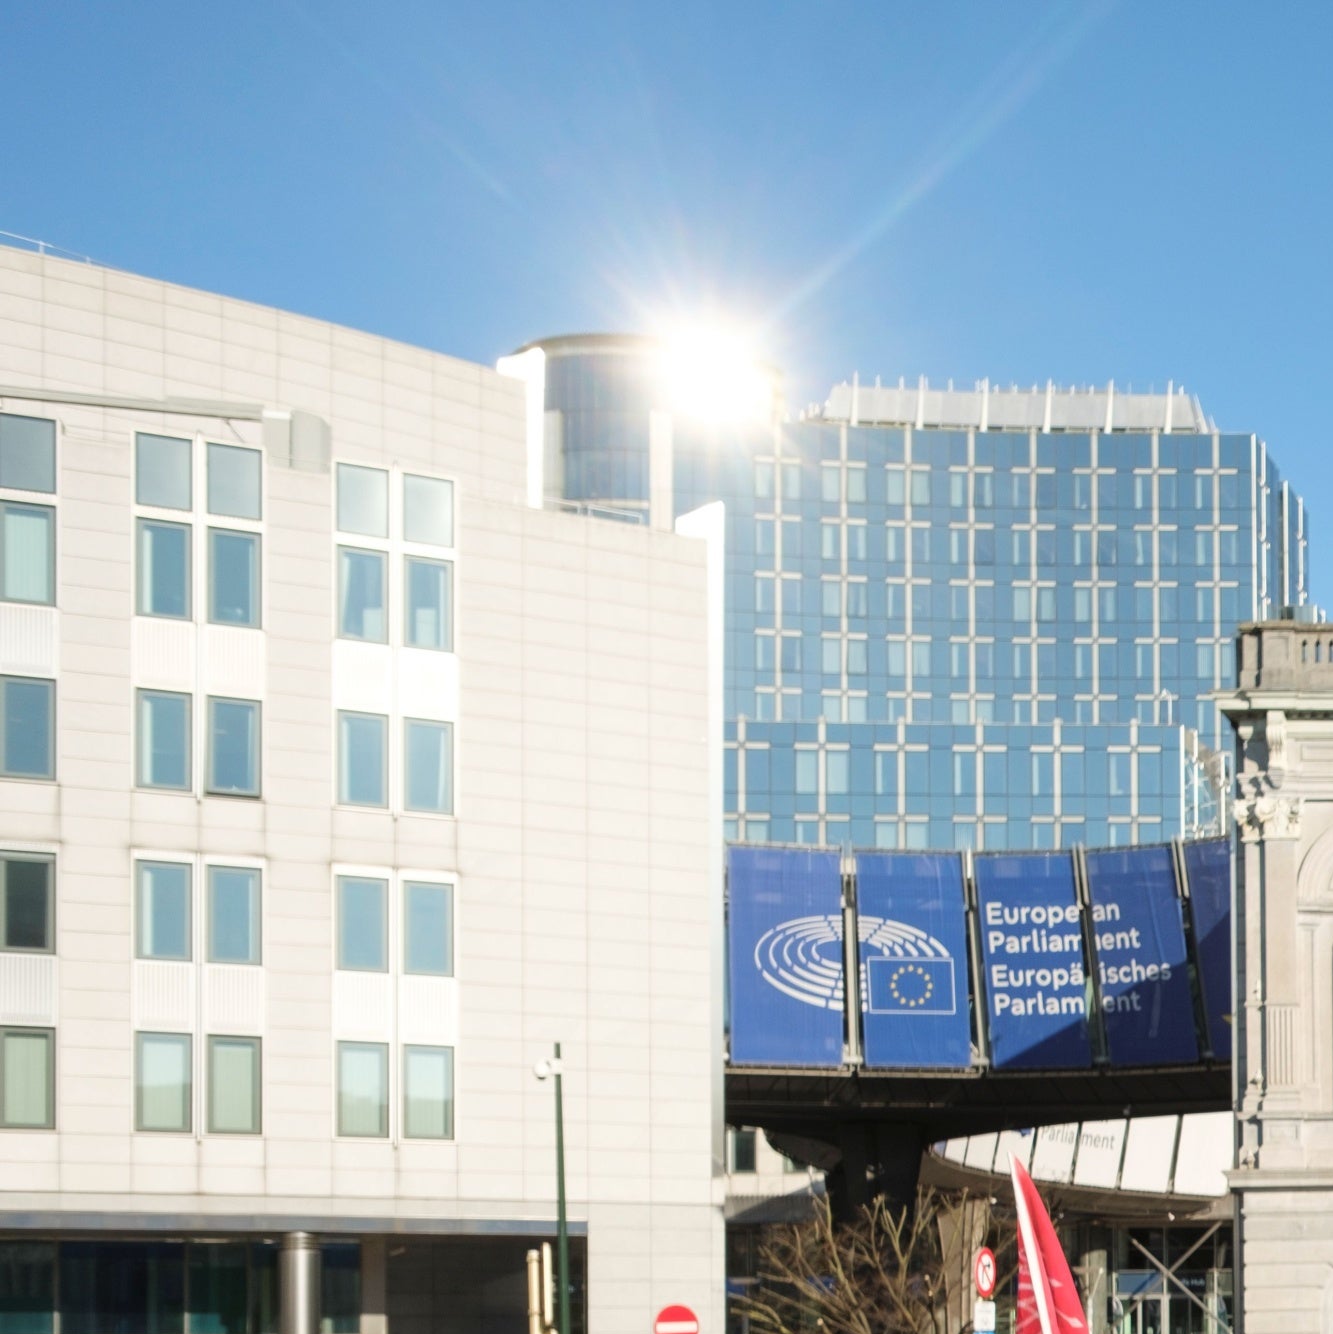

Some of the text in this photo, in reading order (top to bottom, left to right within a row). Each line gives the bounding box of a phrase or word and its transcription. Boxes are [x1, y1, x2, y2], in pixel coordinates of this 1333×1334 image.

[986, 901, 1120, 928] European
[988, 927, 1141, 954] Parliament
[991, 957, 1172, 991] Europäisches
[994, 990, 1142, 1017] Parlament
